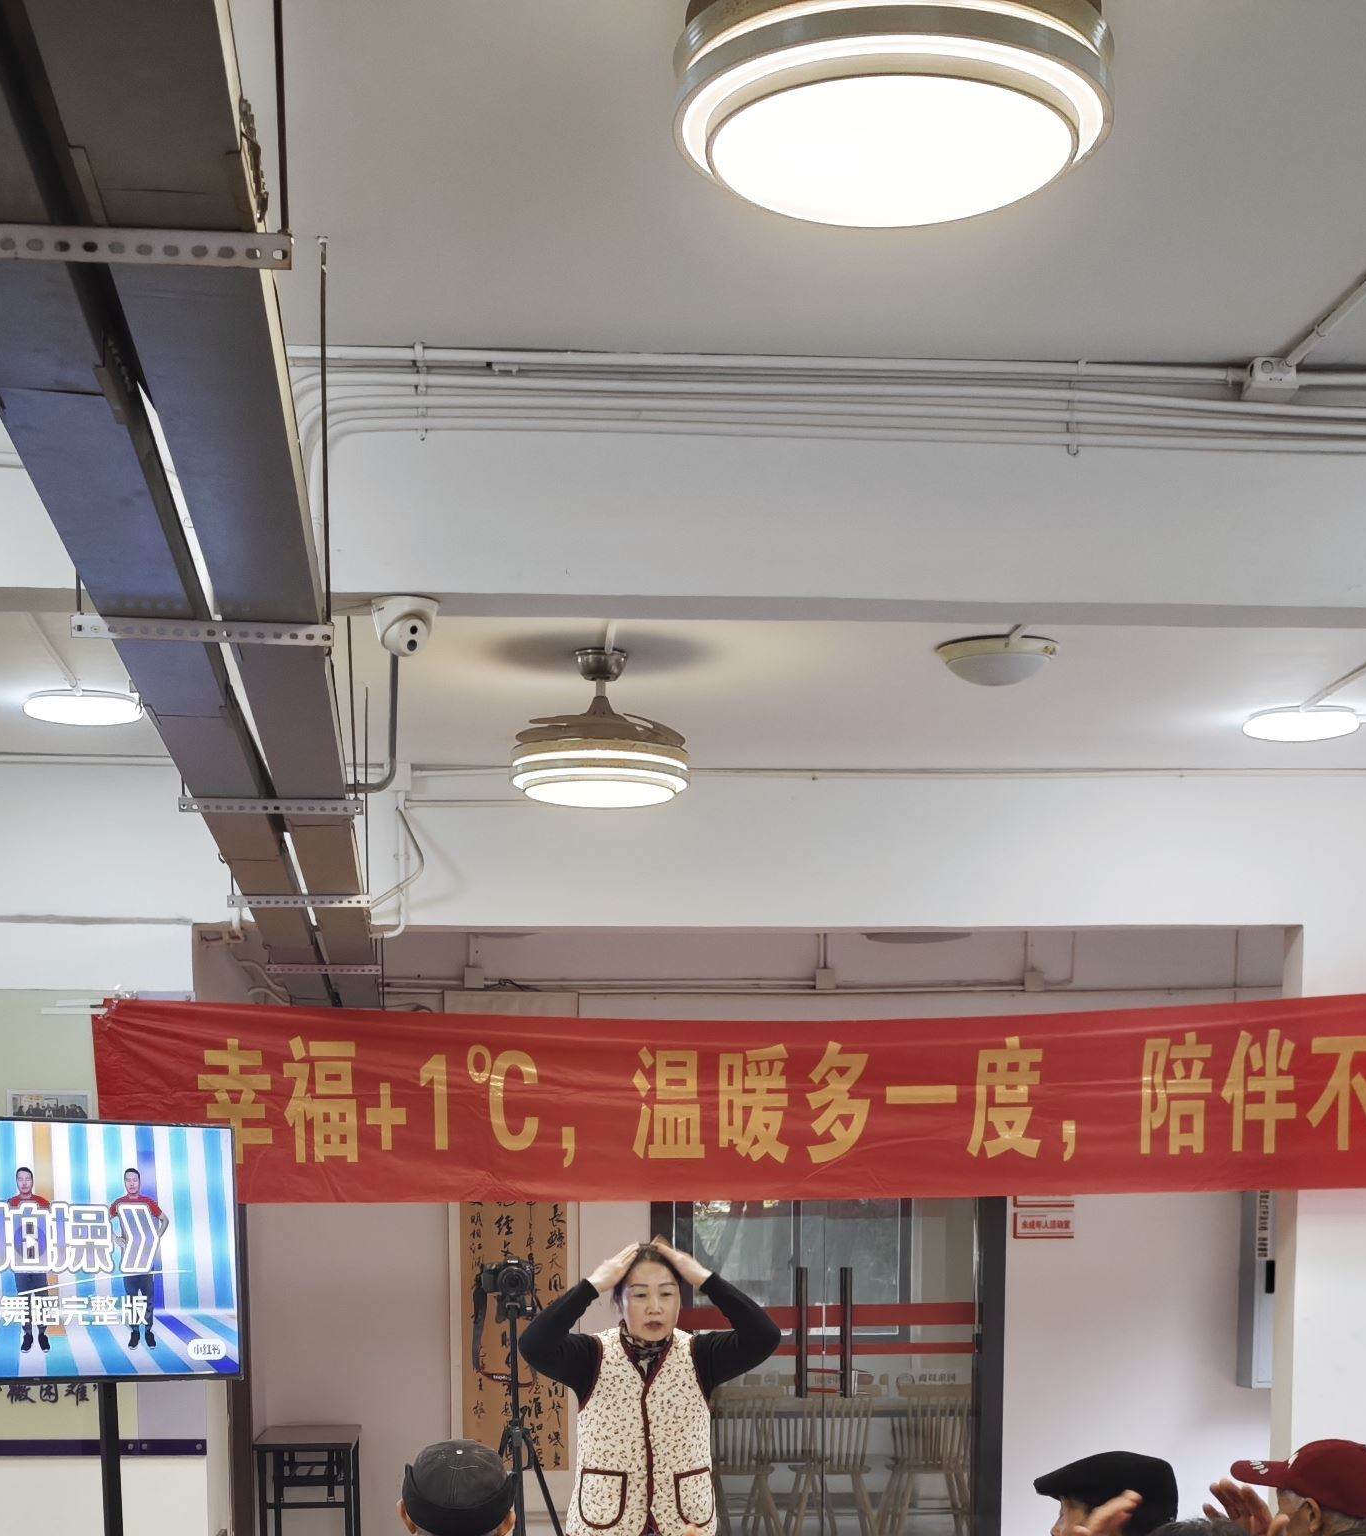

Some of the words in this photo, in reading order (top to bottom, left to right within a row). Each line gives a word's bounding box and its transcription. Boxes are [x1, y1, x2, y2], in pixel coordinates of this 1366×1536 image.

[0, 1296, 148, 1326] 舞蹈完整版
[193, 1344, 221, 1355] 小红书
